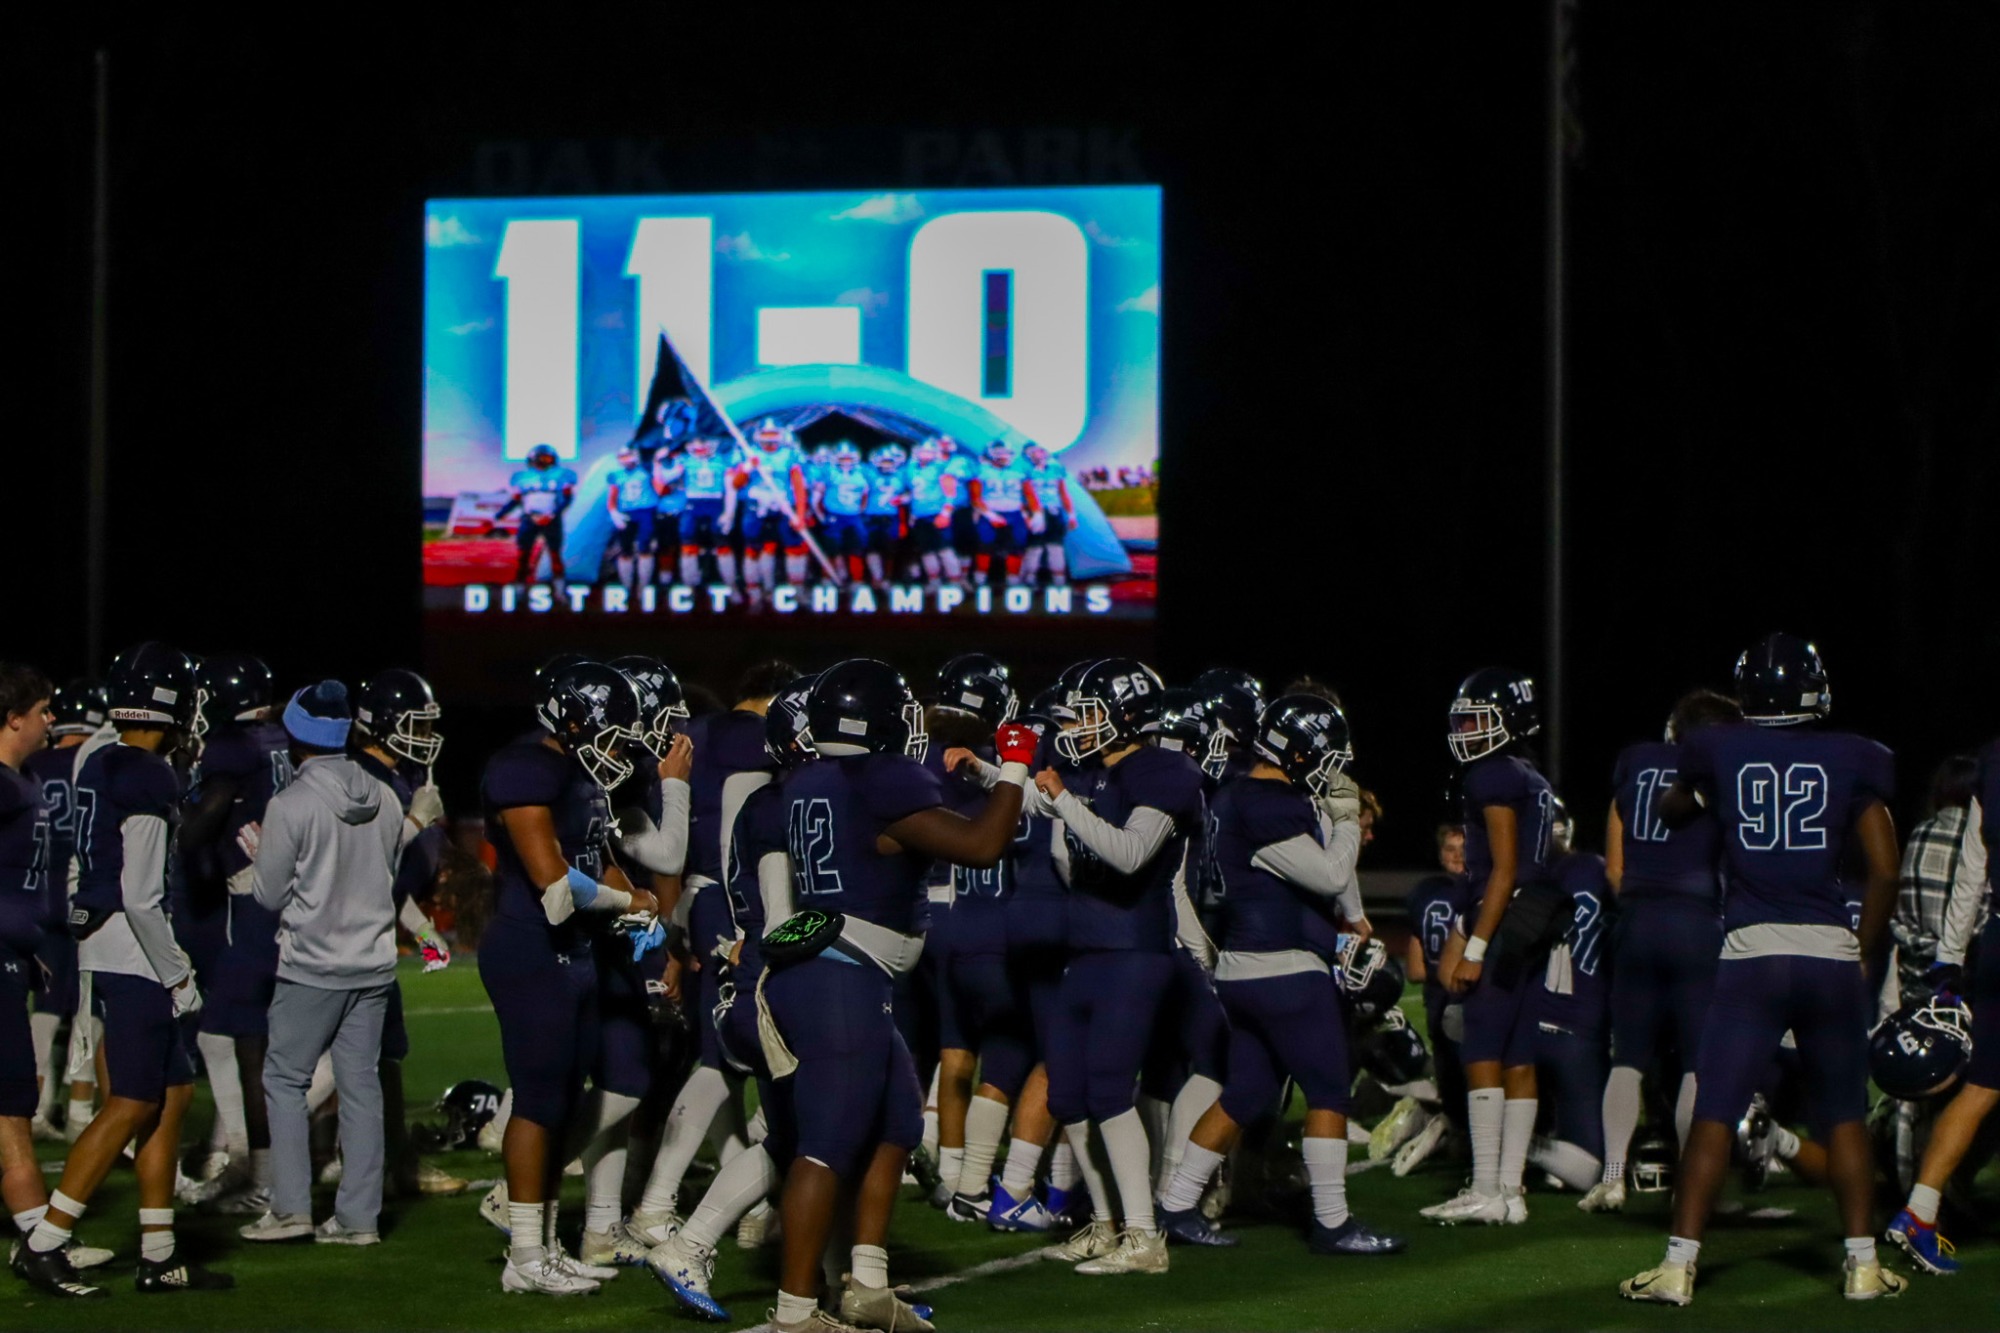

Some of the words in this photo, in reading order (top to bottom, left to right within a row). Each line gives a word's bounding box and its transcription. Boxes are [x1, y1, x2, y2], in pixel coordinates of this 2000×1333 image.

[471, 138, 667, 192] OAK
[901, 127, 1149, 186] PARK
[491, 212, 1089, 461] 11-0
[464, 584, 733, 613] DISTRICT
[773, 584, 1112, 613] CHAMPIONS
[114, 710, 150, 719] Riddell
[1737, 762, 1828, 850] 92
[472, 1093, 500, 1115] 74
